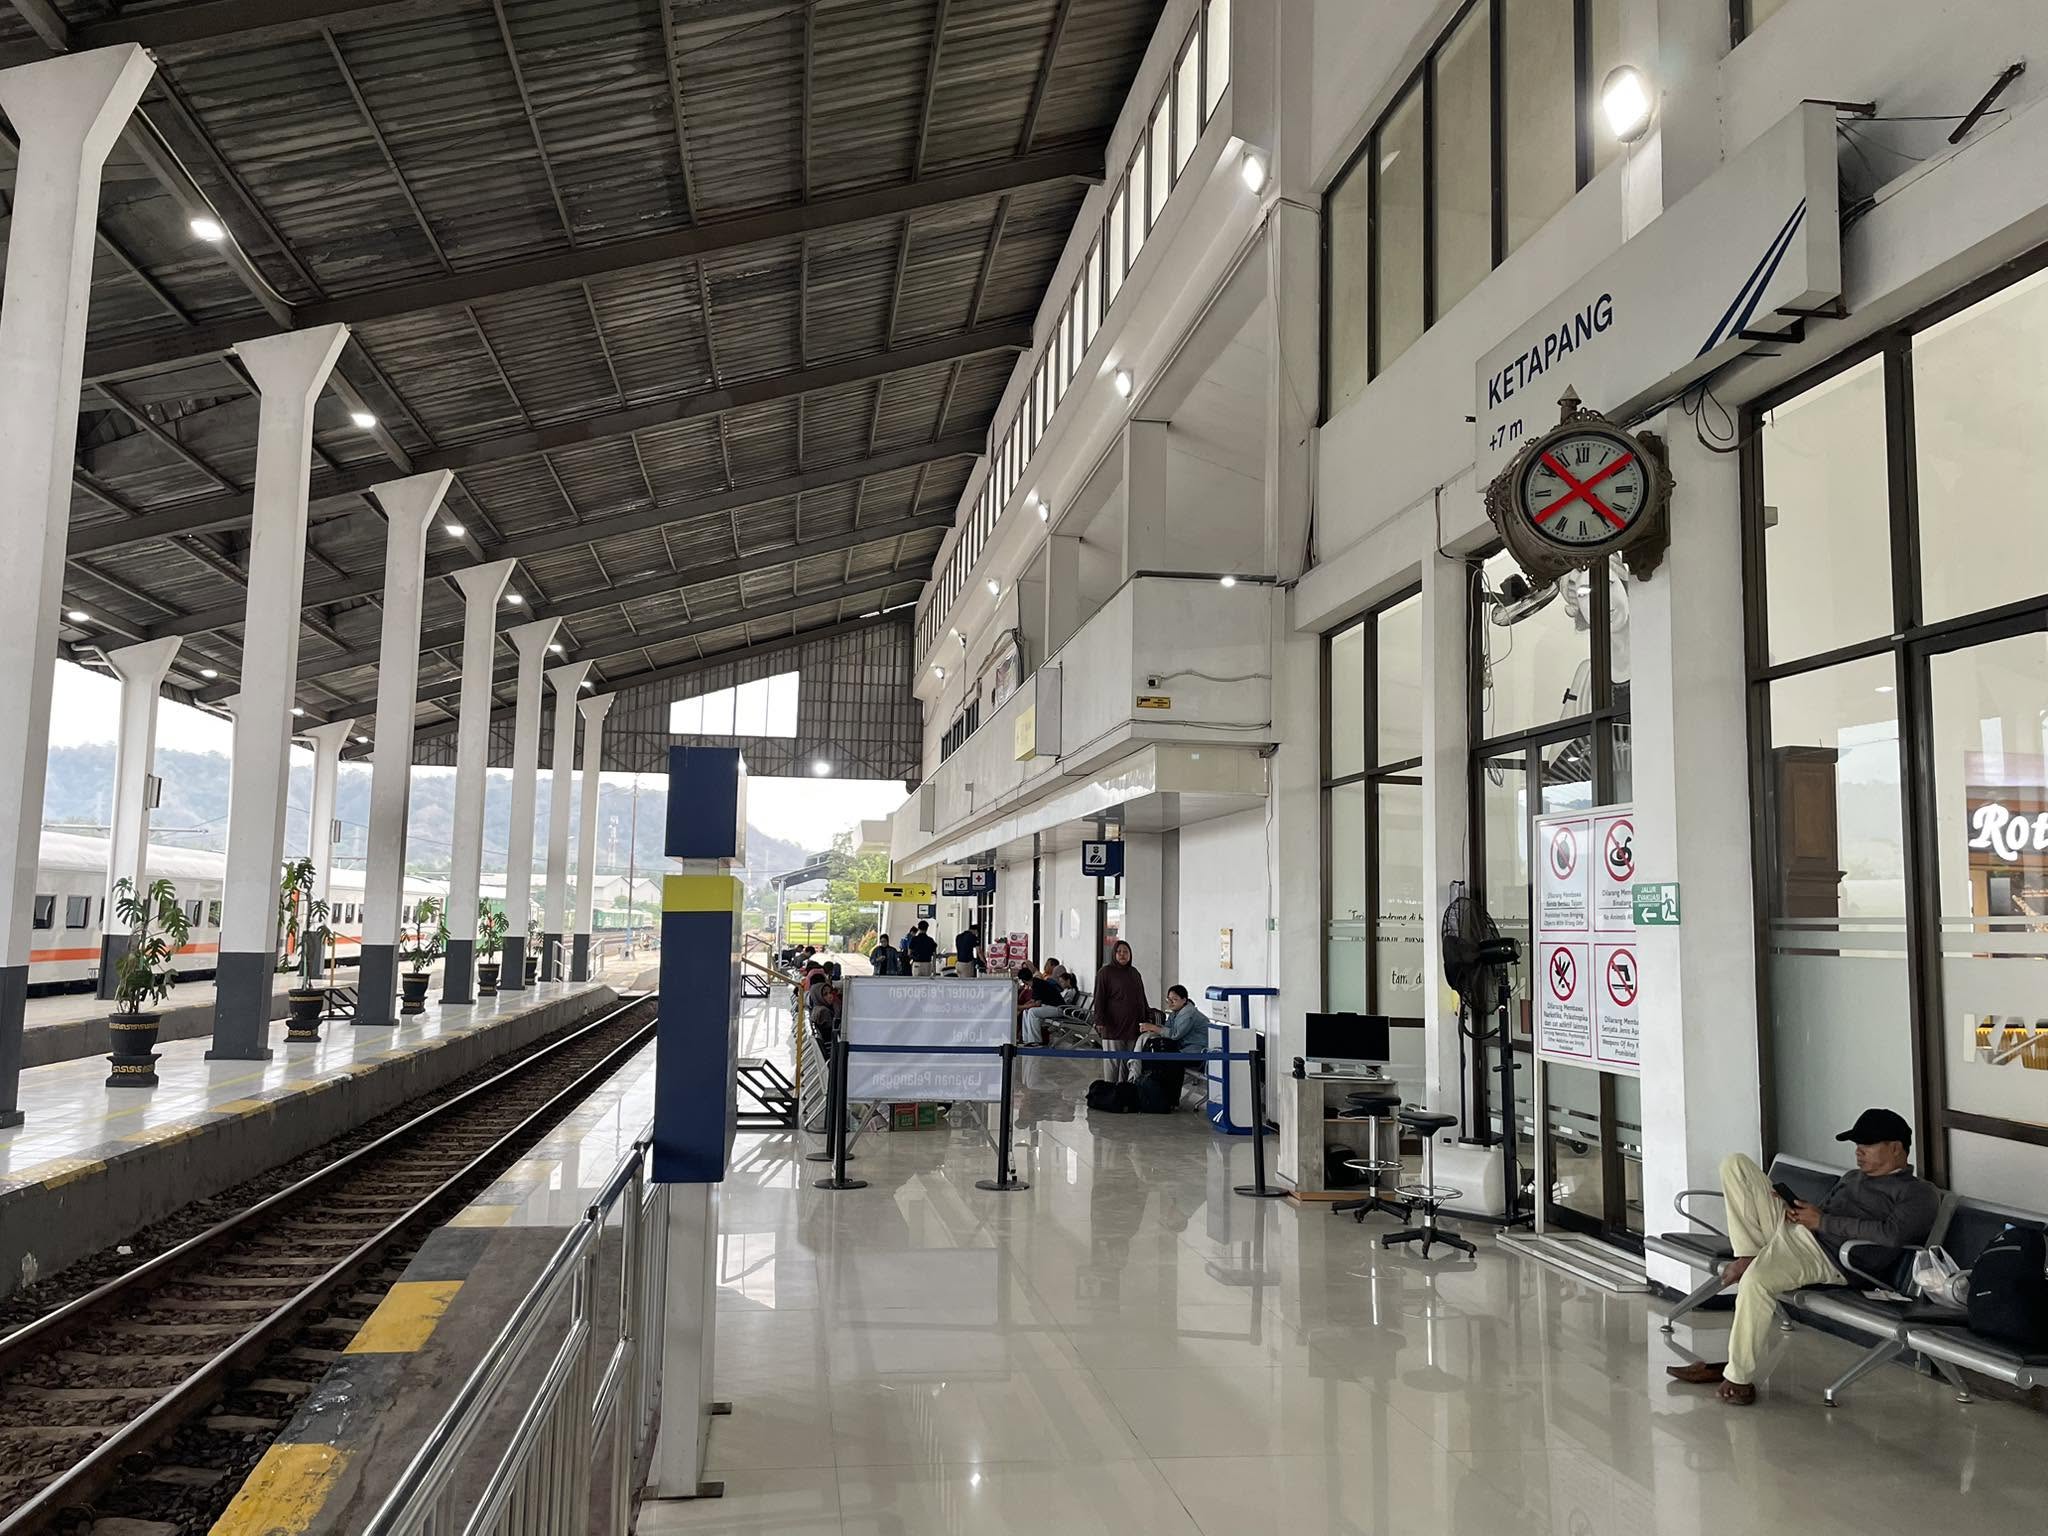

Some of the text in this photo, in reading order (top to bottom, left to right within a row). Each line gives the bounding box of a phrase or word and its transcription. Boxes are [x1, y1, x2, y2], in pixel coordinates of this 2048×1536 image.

[1488, 293, 1613, 410] KETAPANG
[1489, 418, 1523, 451] +7 m
[1602, 889, 1620, 898] Dilarang
[1637, 893, 1660, 901] EVAKUASI
[1547, 1001, 1562, 1011] Dilarang
[1604, 1016, 1639, 1026] Dilarang Memba
[1602, 1025, 1618, 1033] Senjata
[1620, 1040, 1626, 1049] Of
[1627, 1041, 1635, 1050] Any
